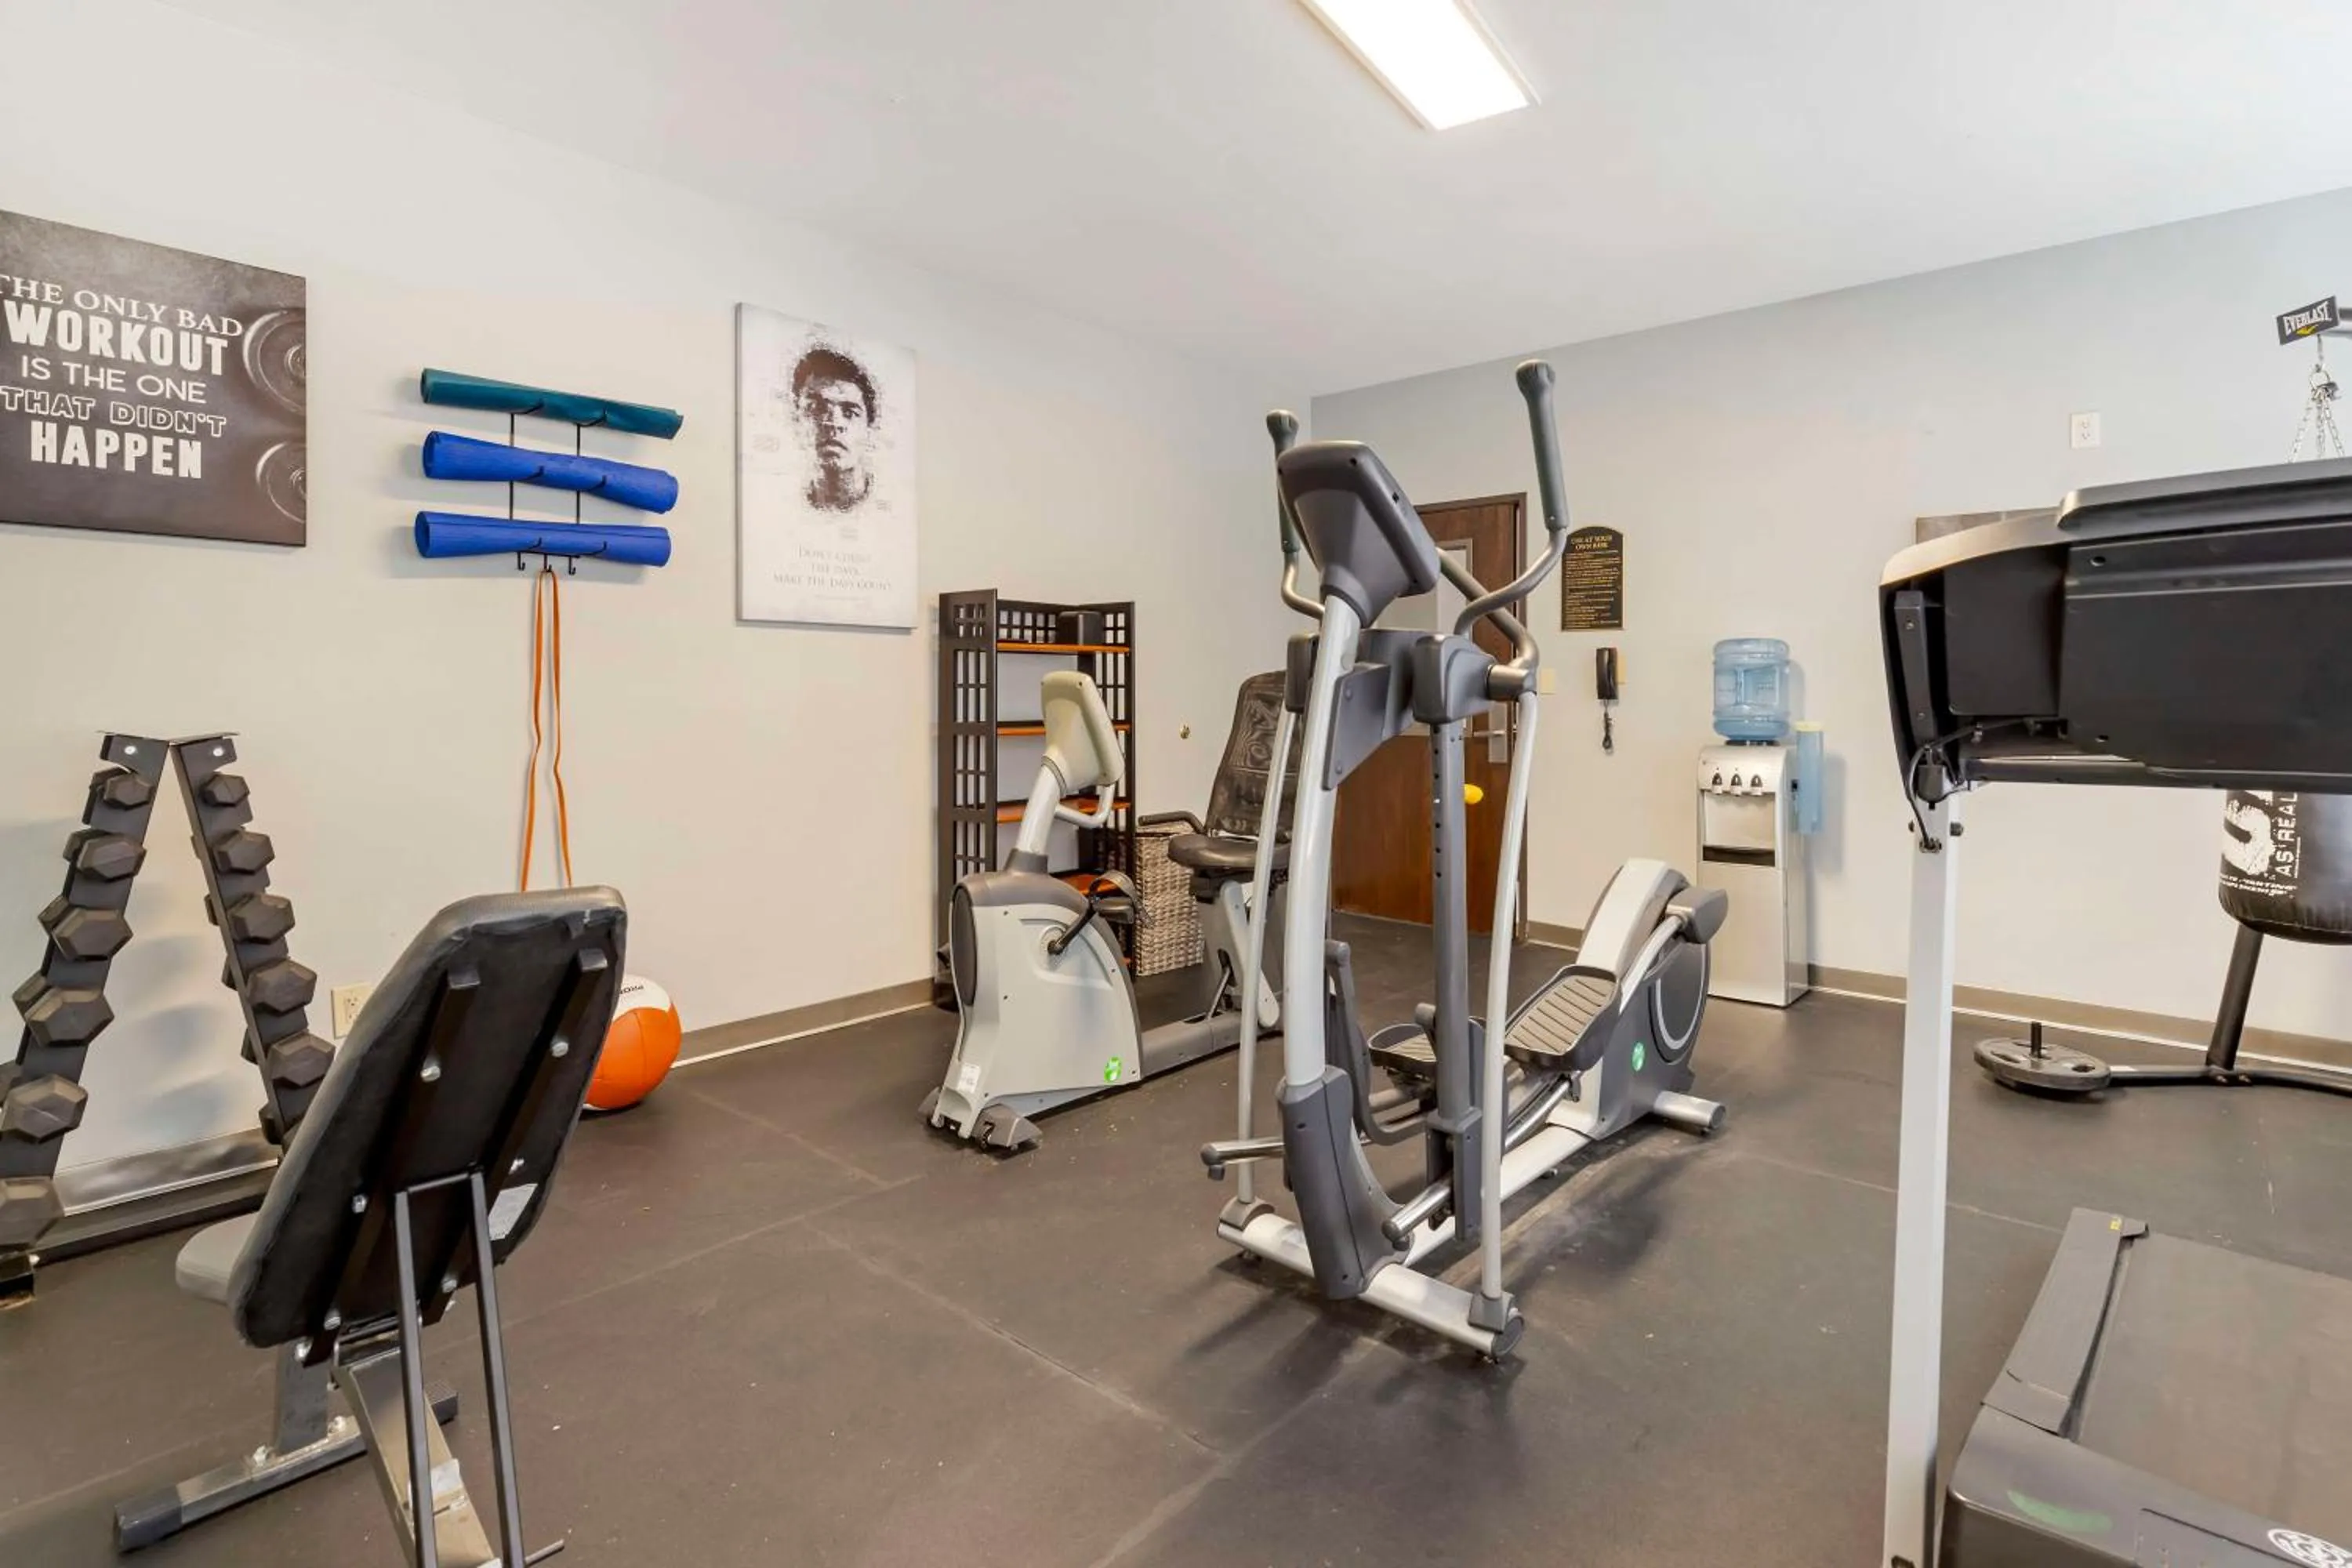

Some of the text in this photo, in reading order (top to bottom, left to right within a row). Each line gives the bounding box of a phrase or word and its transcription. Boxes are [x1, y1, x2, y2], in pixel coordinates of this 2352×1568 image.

[3, 299, 229, 376] WORKOUT
[74, 289, 168, 324] ONLY
[178, 309, 242, 336] BAD
[2282, 300, 2333, 336] EVERLAST
[21, 354, 207, 404] IS THE ONE
[0, 385, 227, 437] THAT DIDN'T
[31, 420, 201, 479] HAPPEN
